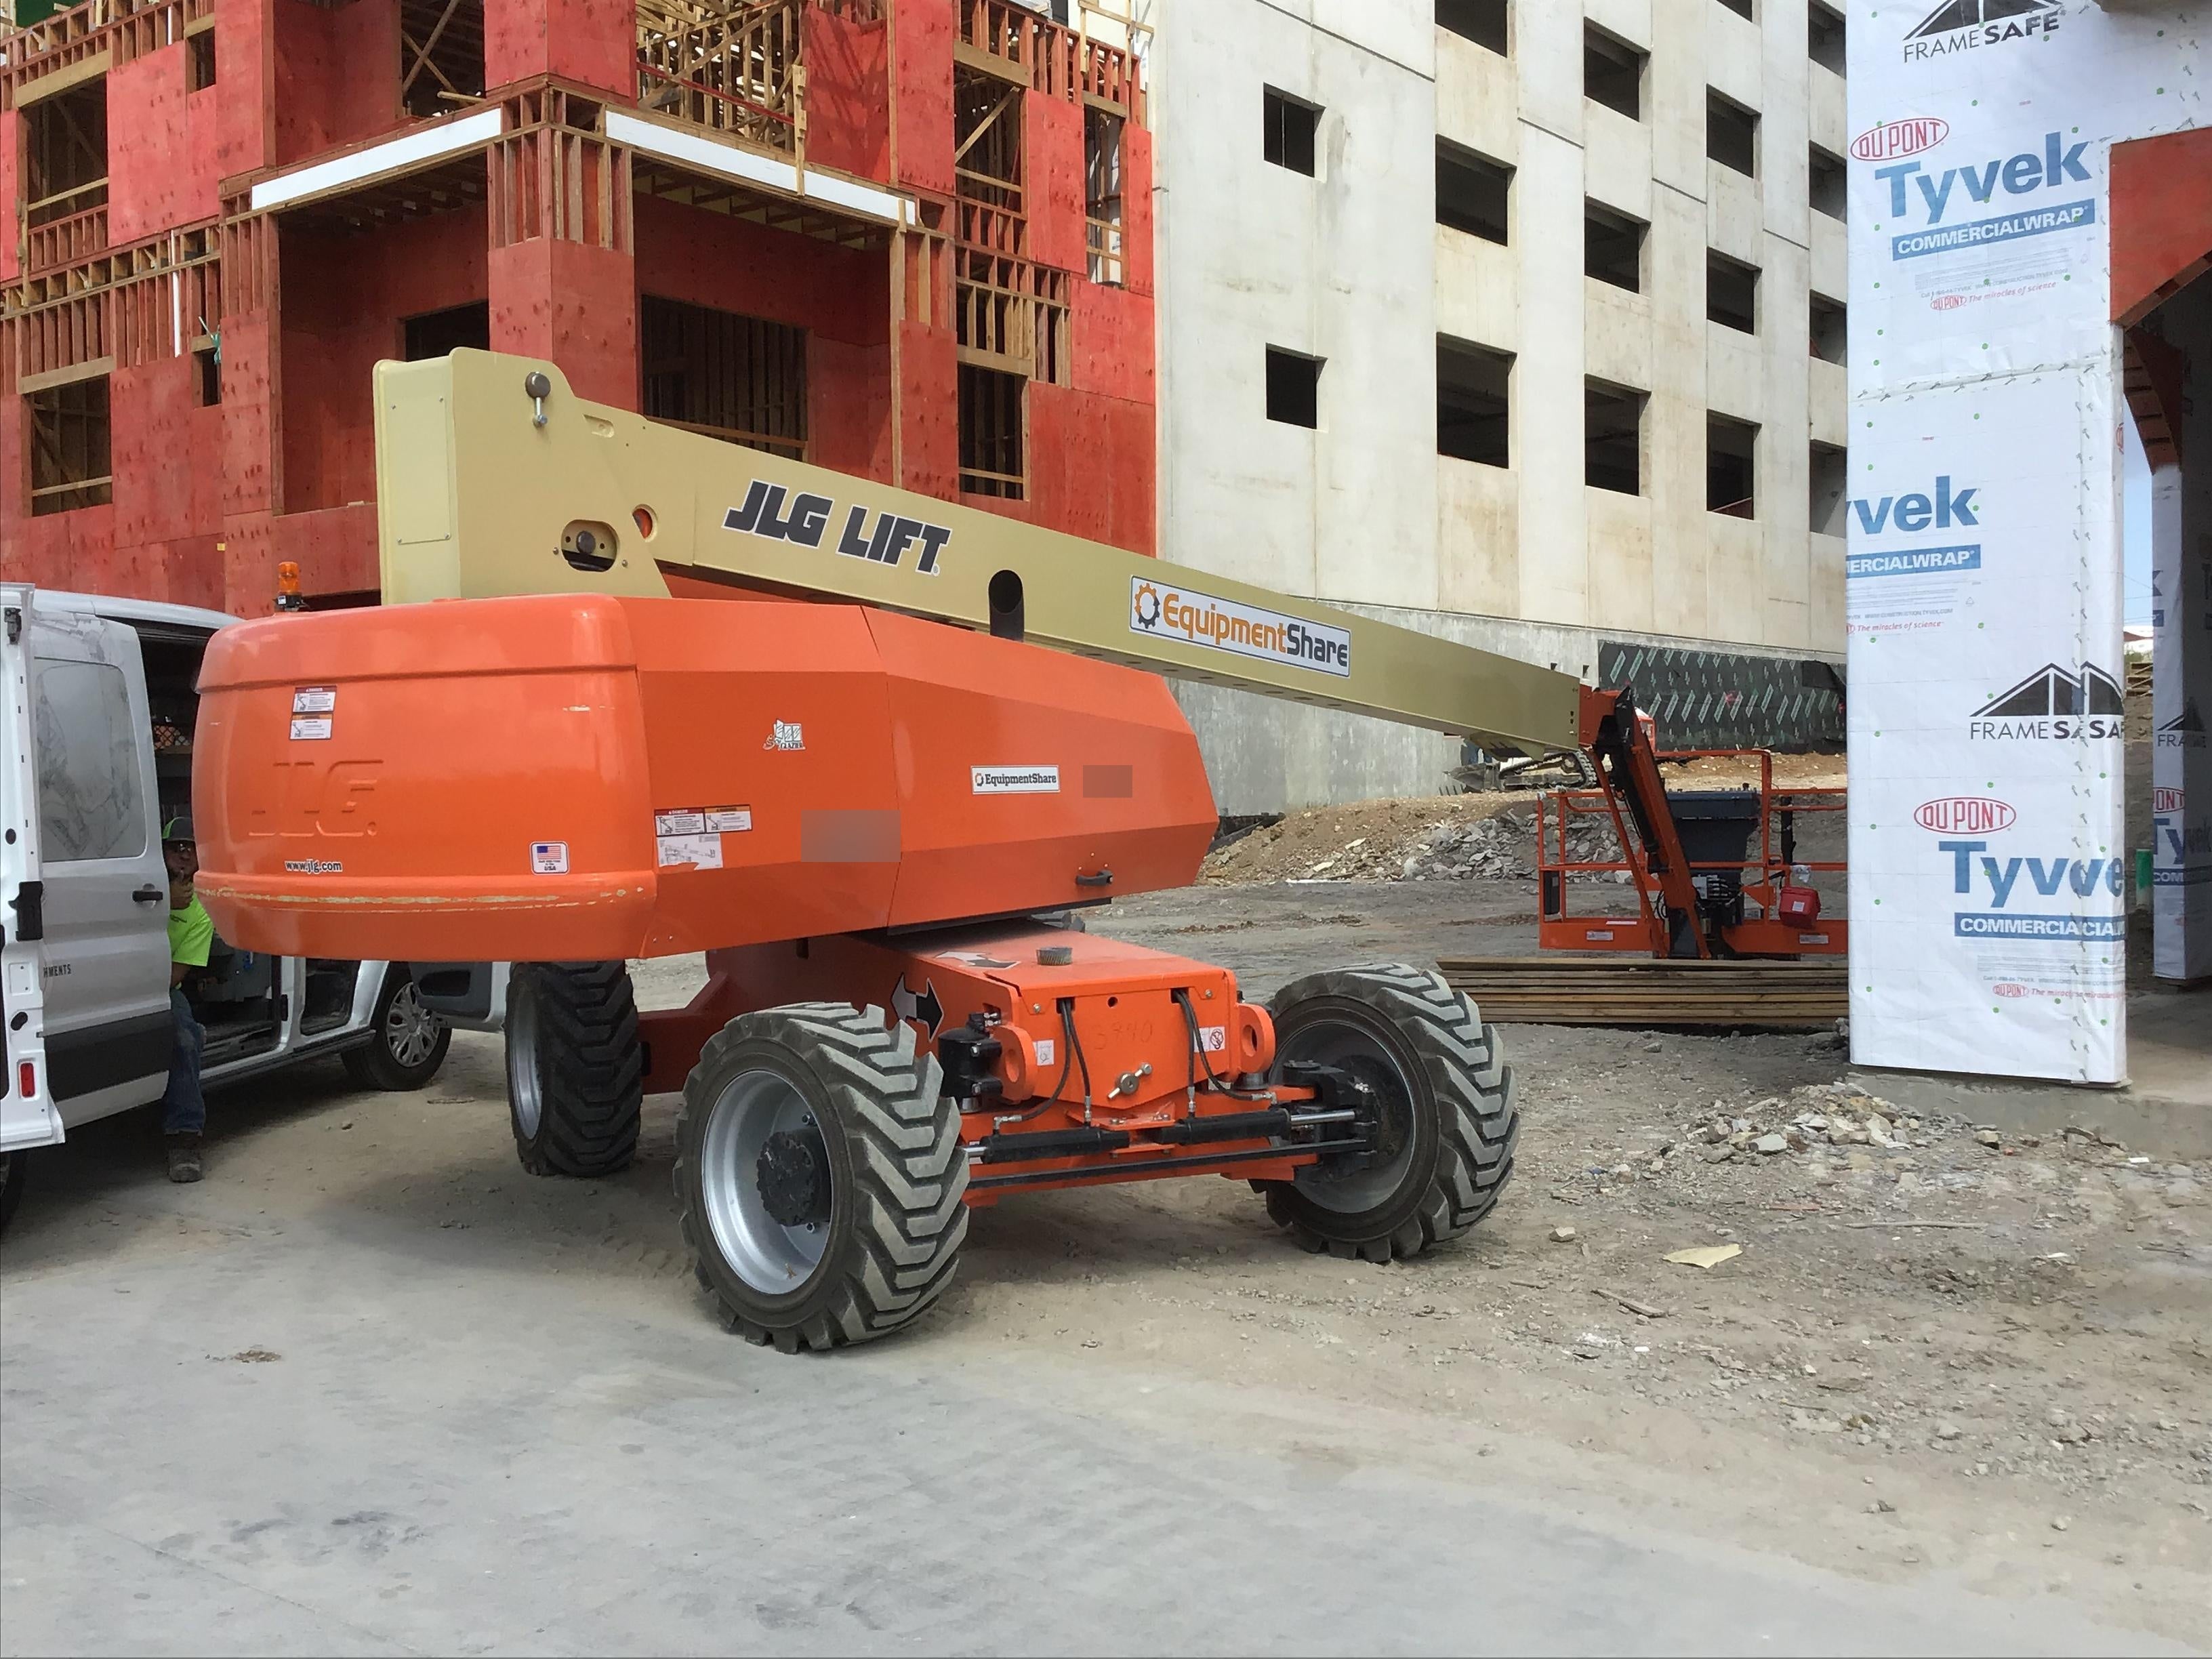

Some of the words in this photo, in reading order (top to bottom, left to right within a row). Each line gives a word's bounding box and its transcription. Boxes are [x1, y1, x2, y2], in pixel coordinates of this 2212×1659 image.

[1875, 132, 2093, 225] Tyvek
[1897, 206, 2085, 254] COMMERCIALWRAP
[722, 478, 834, 550] JLG
[835, 504, 953, 575] LIFT
[1847, 550, 1971, 573] ERCIALWRAP
[1163, 593, 1348, 668] EquipmentShare
[1858, 624, 1870, 632] The
[1903, 621, 1912, 631] of
[1914, 620, 1942, 629] science
[985, 773, 1057, 787] EquipmentShare
[285, 859, 342, 874] www.jlg.com
